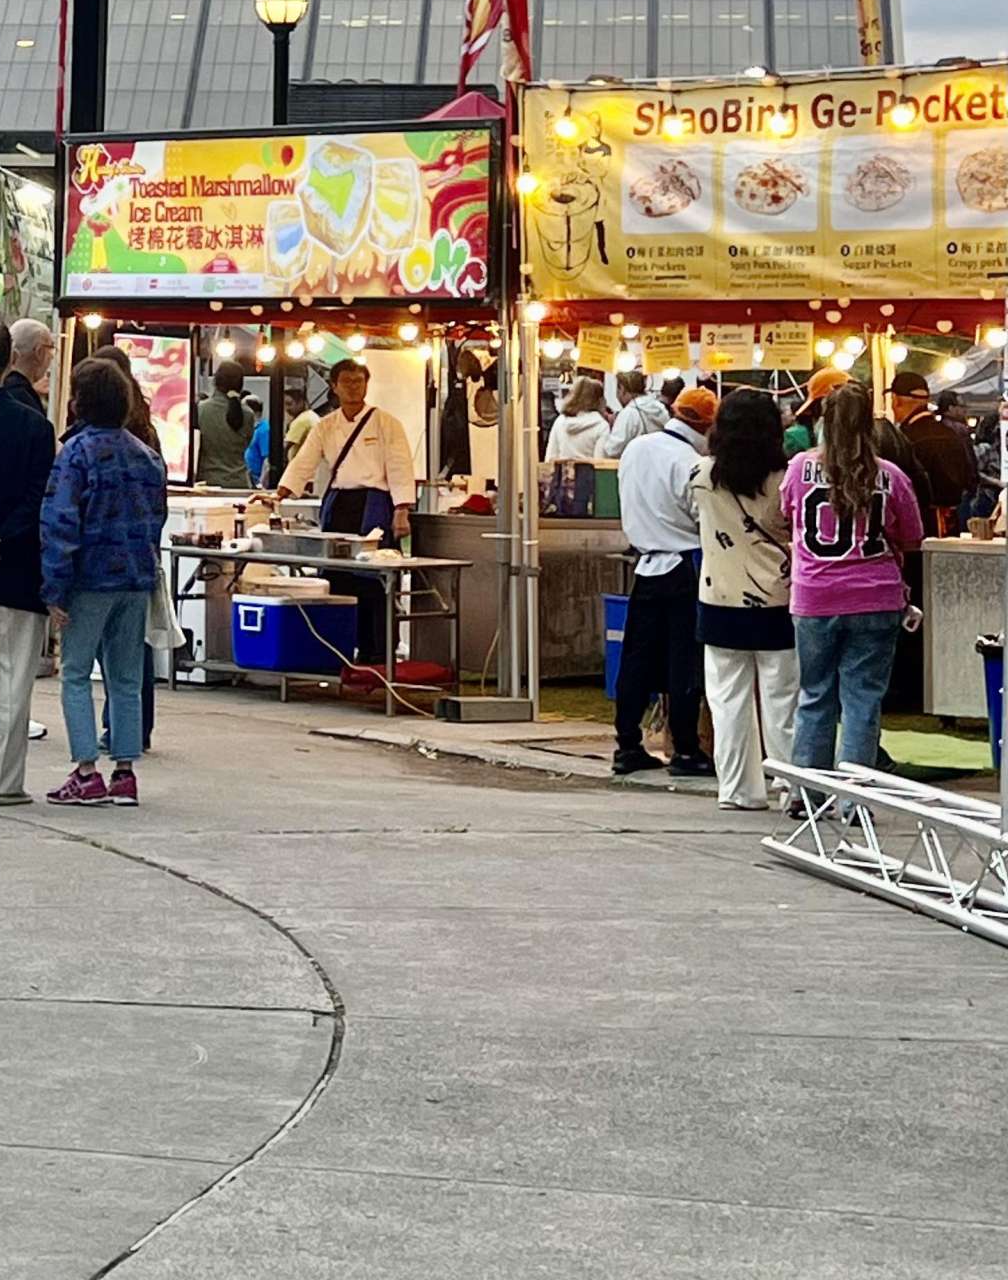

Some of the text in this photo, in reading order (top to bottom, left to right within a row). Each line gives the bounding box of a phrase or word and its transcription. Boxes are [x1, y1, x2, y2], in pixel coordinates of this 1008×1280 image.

[810, 84, 1008, 129] Ge-Pocket
[129, 174, 296, 199] Toasted Marshmallow
[129, 201, 203, 223] Ice Cream
[128, 223, 265, 250] 烤棉花糖冰淇淋
[645, 335, 654, 350] 2
[706, 331, 715, 346] 3
[764, 330, 774, 345] 4
